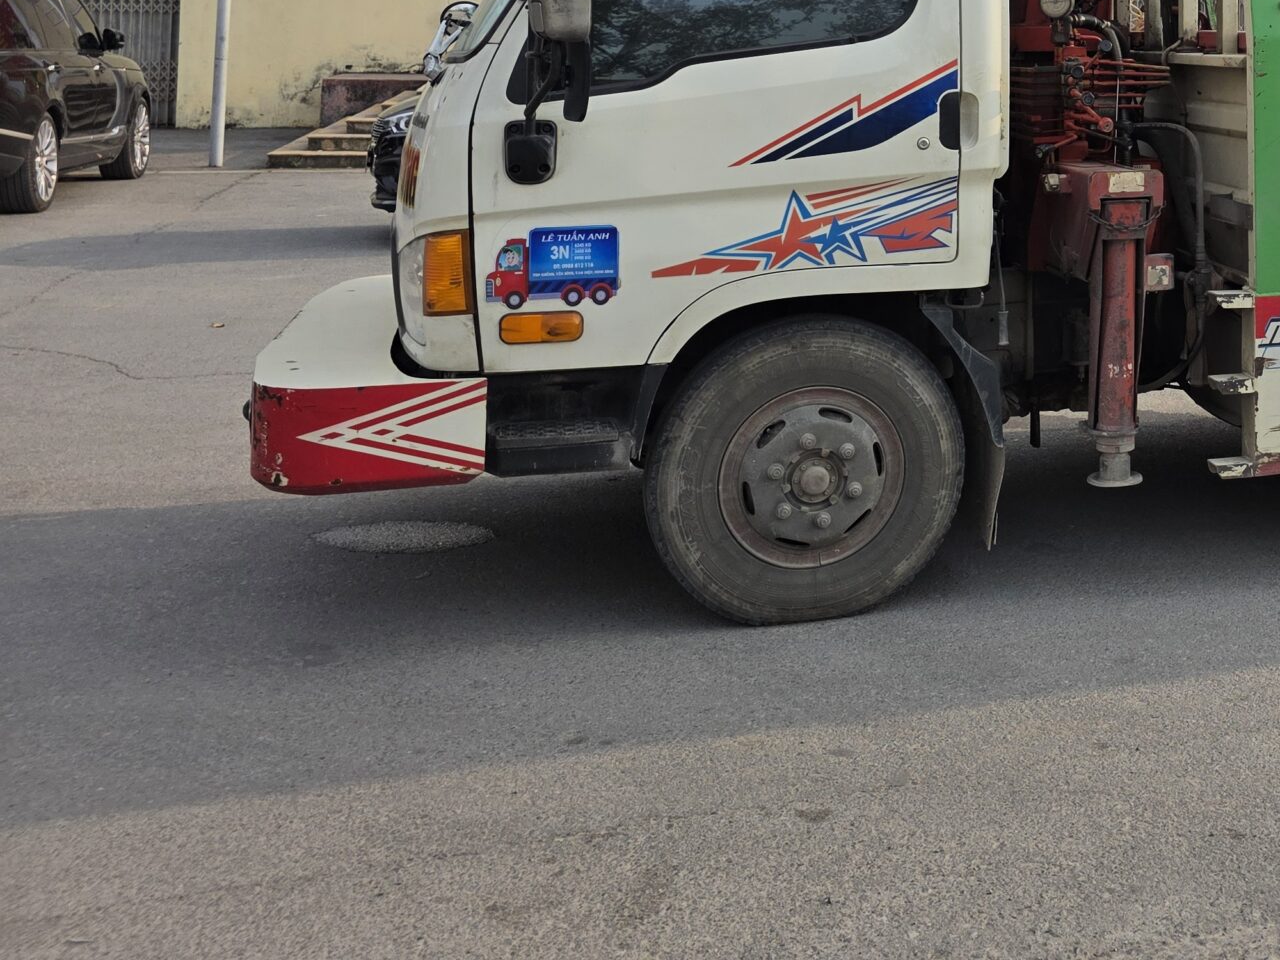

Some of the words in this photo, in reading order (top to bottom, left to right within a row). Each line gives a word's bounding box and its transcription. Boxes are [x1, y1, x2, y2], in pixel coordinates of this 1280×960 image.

[542, 234, 556, 243] LÊ
[556, 230, 585, 241] TUẤN
[550, 245, 569, 260] 3N
